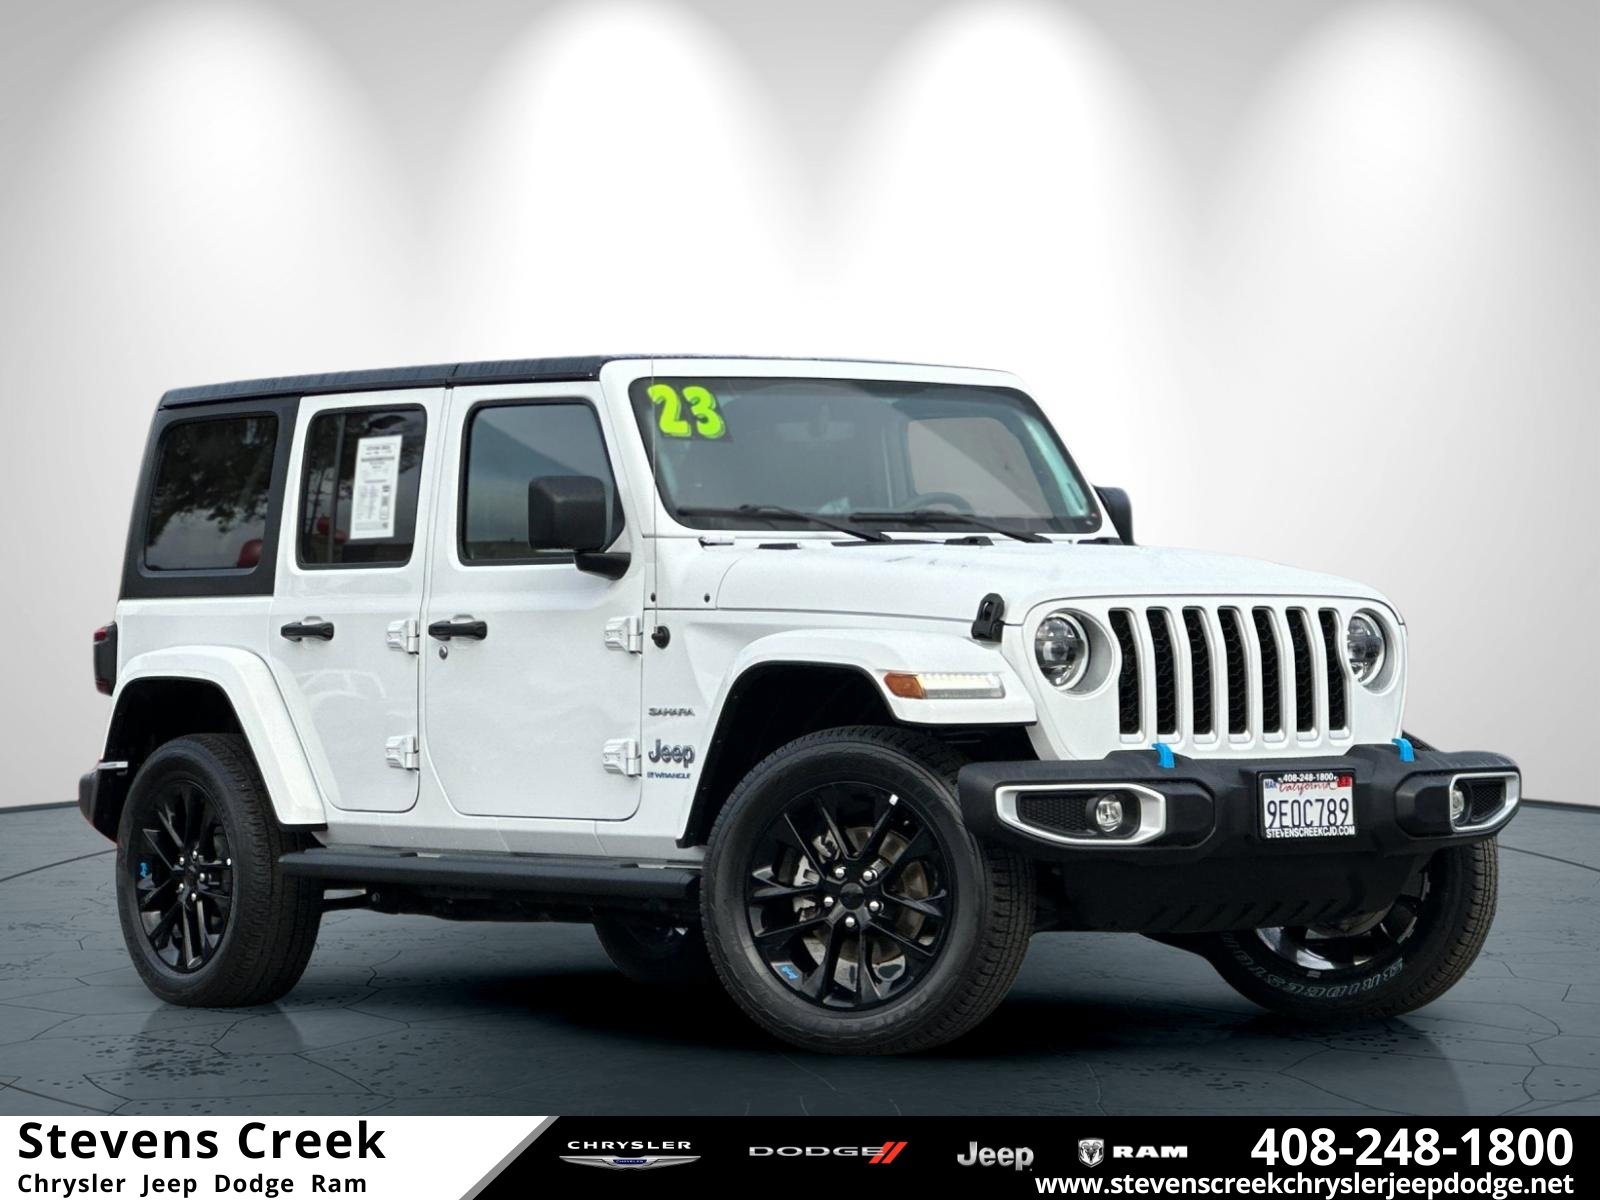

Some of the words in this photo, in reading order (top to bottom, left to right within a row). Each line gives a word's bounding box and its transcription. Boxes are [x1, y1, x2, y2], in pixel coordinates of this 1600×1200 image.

[647, 384, 726, 439] 23
[648, 707, 695, 717] SAHARA
[648, 739, 695, 769] Jeep
[1283, 773, 1334, 782] 408-248-1800
[1266, 826, 1355, 838] STEVENSCREEKCJD.COM
